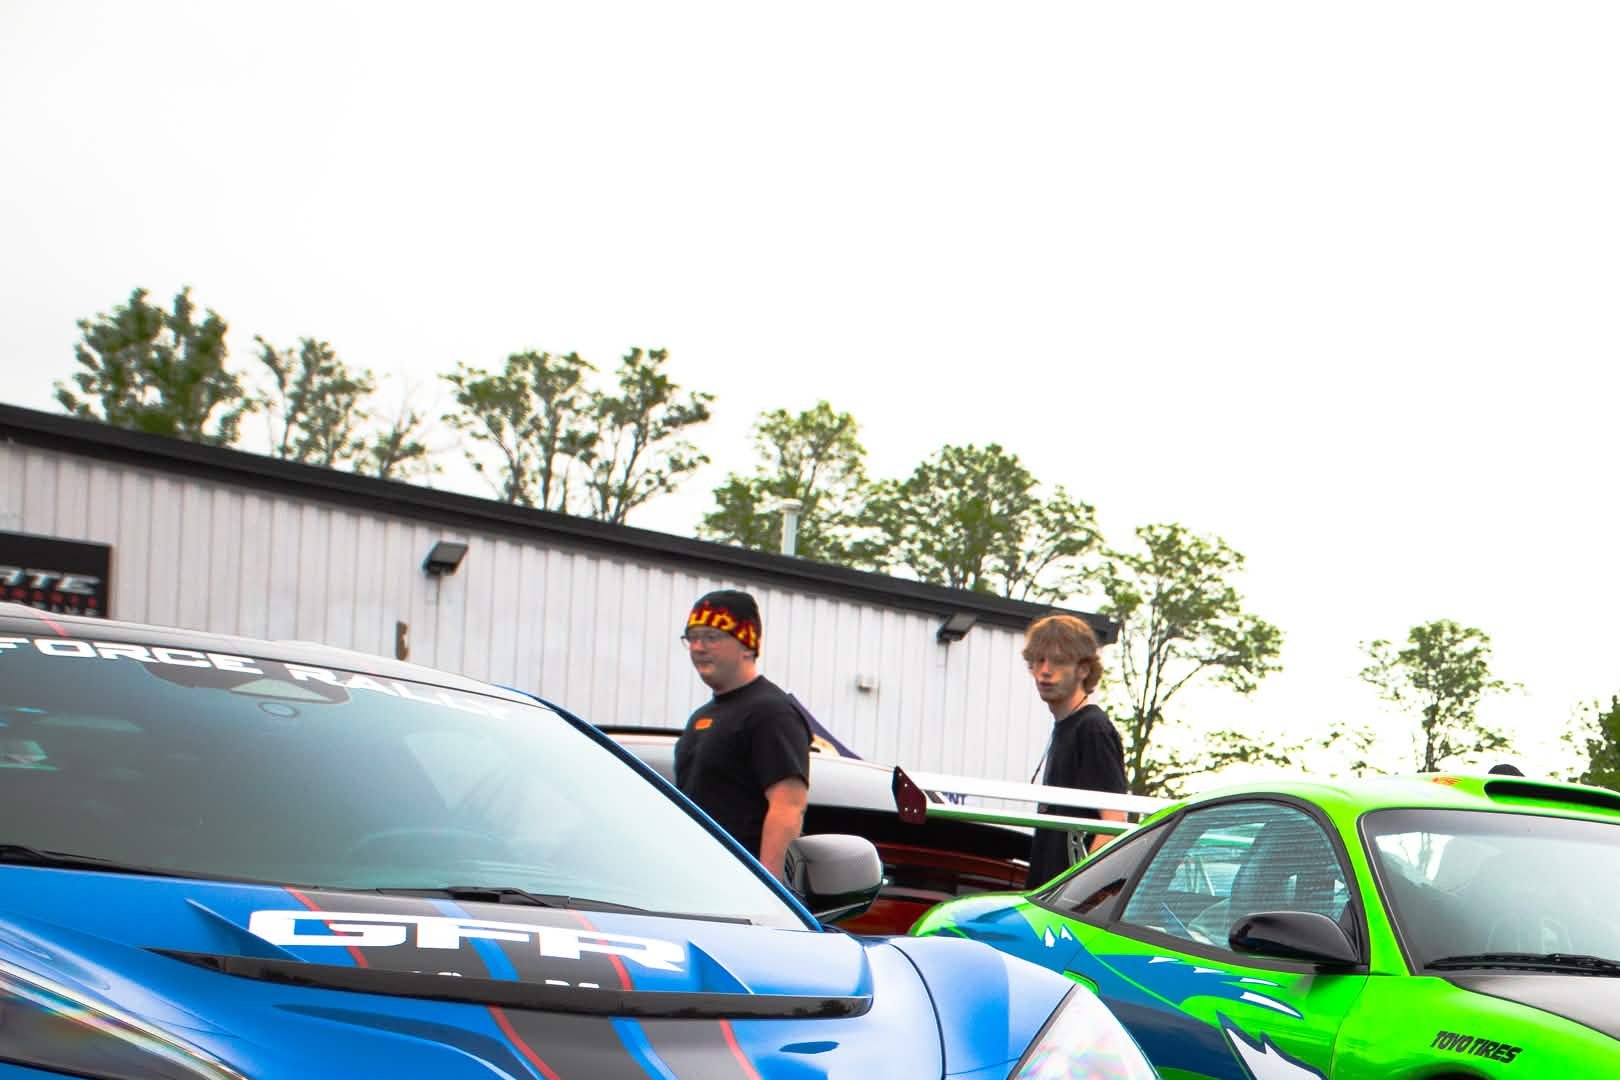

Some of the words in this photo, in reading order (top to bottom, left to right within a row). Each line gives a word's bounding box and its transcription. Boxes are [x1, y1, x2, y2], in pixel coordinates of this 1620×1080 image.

[248, 910, 687, 972] GFR
[1430, 1030, 1475, 1053] TOYO
[1467, 1037, 1524, 1064] TIRES
